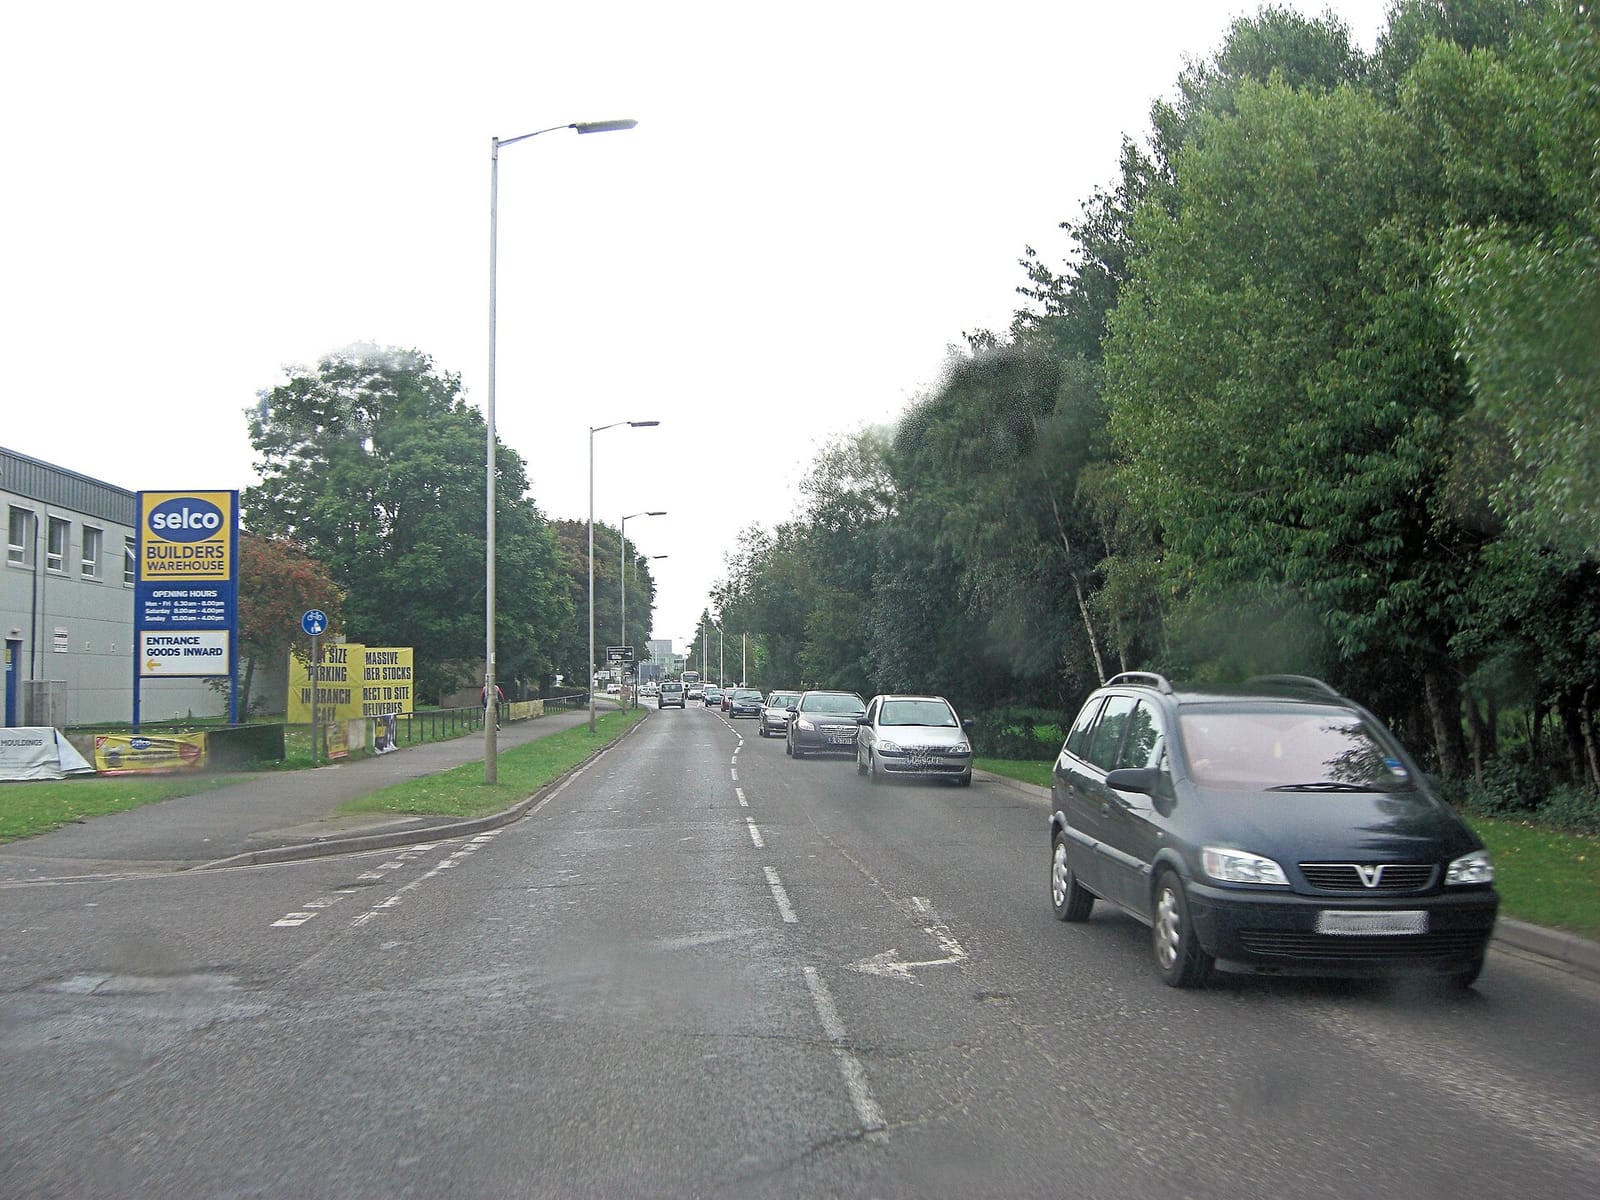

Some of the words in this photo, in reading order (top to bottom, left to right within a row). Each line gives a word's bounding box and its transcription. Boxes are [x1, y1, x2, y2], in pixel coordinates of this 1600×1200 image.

[153, 507, 220, 530] selco
[147, 546, 224, 559] BUILDERS
[147, 560, 224, 571] WAREHOUSE
[152, 590, 188, 598] OPENING
[189, 590, 218, 598] HOURS
[146, 636, 201, 645] ENTRANCE
[146, 648, 181, 657] GOODS
[183, 647, 223, 656] INWARD
[329, 648, 347, 664] SIZE
[365, 651, 399, 665] MASSIVE
[307, 666, 347, 682] PRKING
[382, 666, 412, 680] STOCKS
[301, 688, 311, 705] IN
[383, 687, 392, 700] TO
[394, 686, 409, 700] SITE
[363, 702, 403, 716] DELIVERIES
